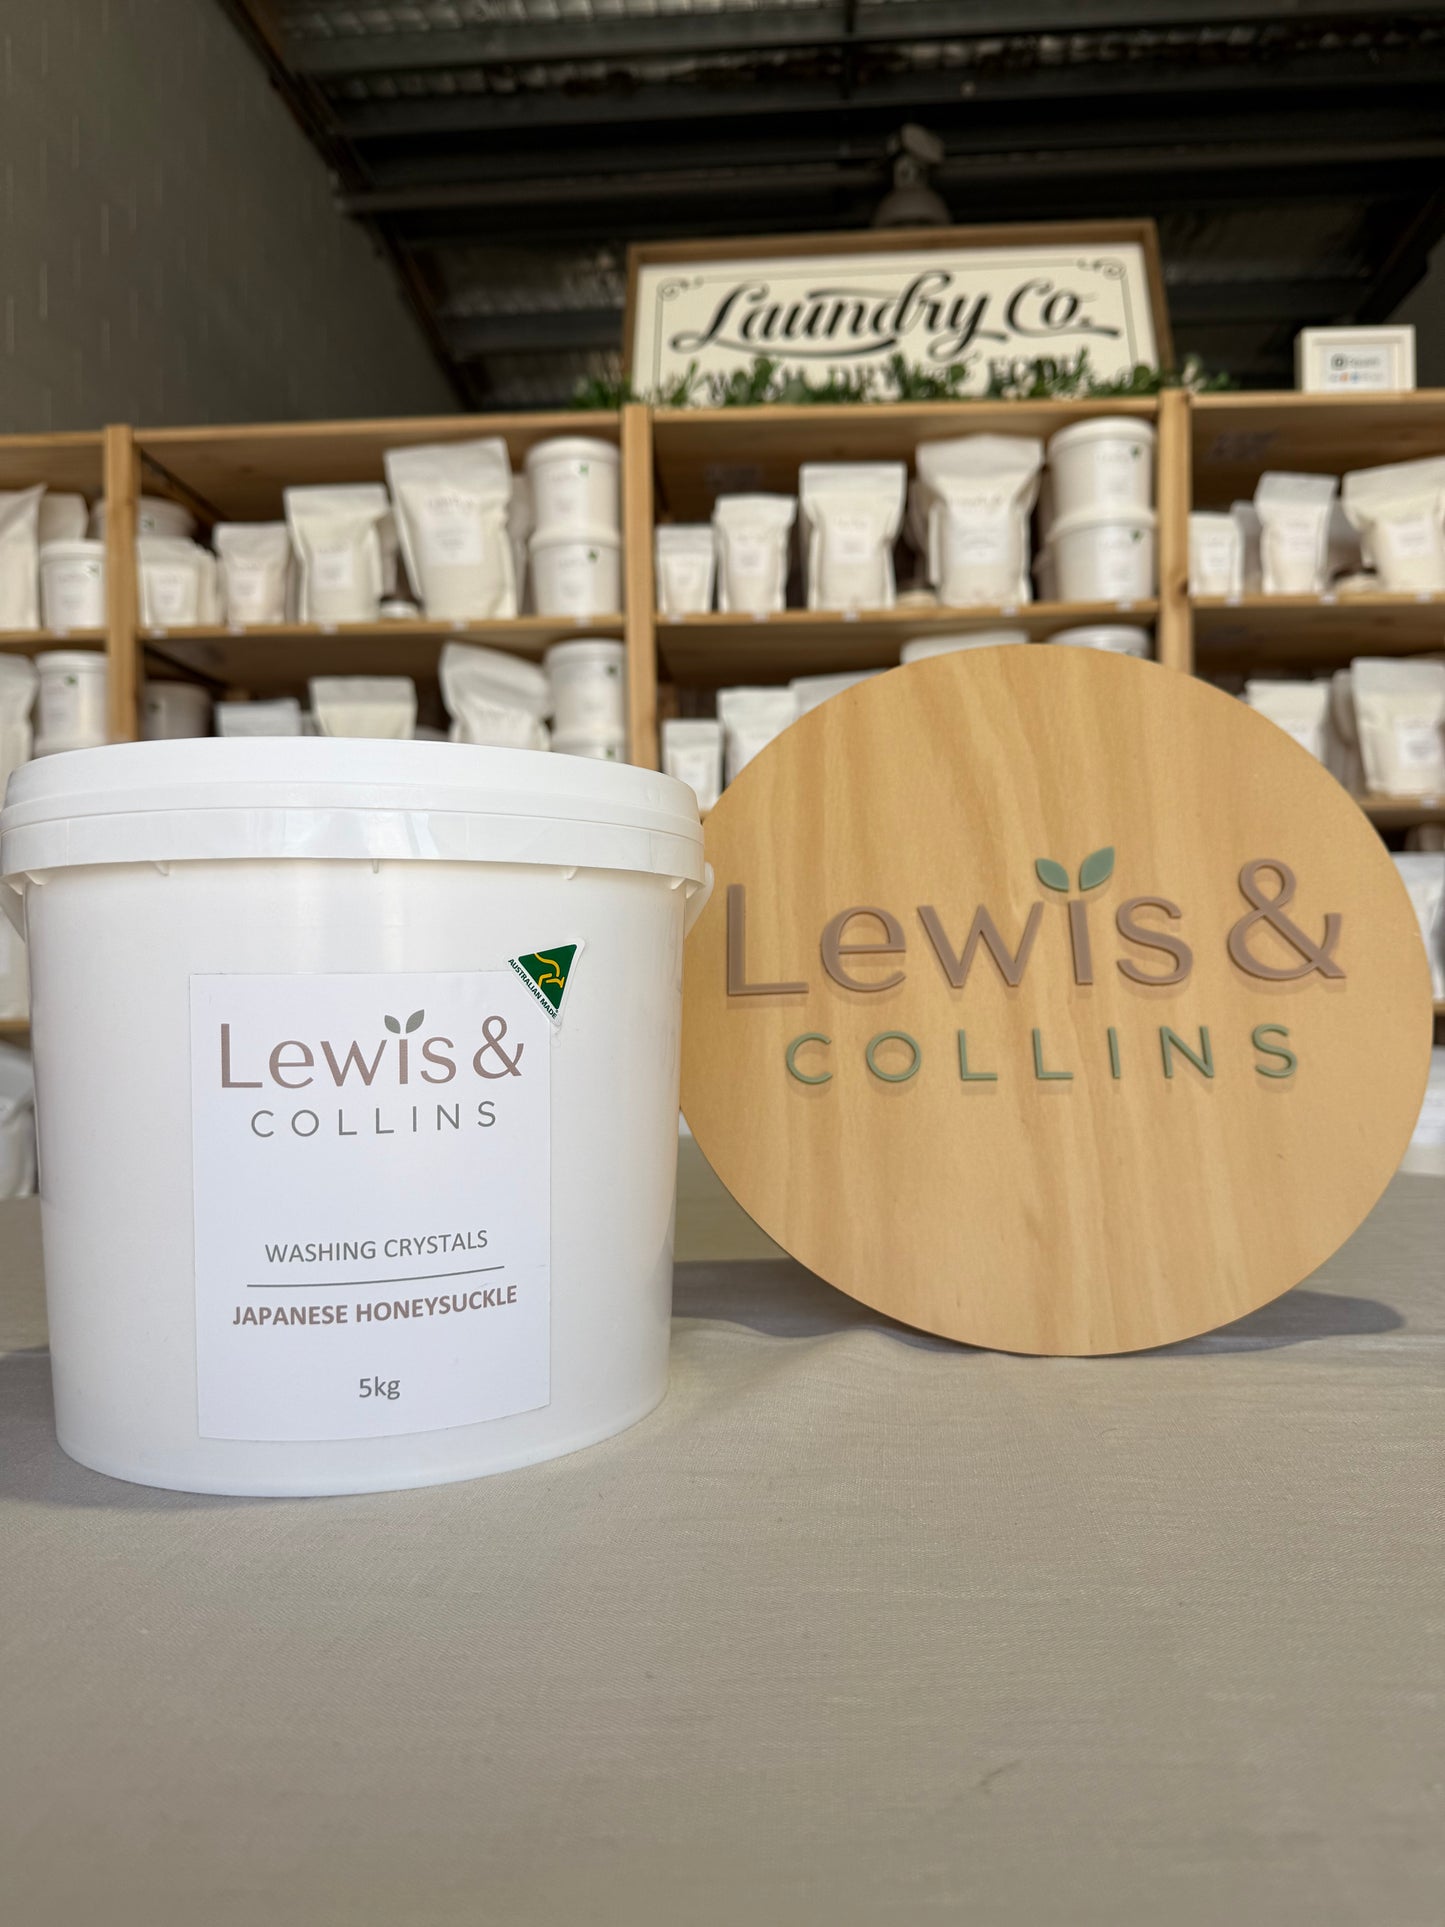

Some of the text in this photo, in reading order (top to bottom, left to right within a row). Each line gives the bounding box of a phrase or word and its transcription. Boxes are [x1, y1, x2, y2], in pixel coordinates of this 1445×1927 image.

[669, 269, 1122, 363] Laundry Co.
[726, 846, 1347, 997] Lewis &
[508, 958, 541, 1000] AUSTRALIAN
[220, 1010, 525, 1089] Lewis &
[785, 1023, 1299, 1085] COLLINS
[250, 1100, 497, 1138] COLLINS
[265, 1229, 488, 1263] WASHING CRYSTALS
[232, 1284, 518, 1326] JAPANESE HONEYSUCKLE
[358, 1375, 401, 1400] 5kg
